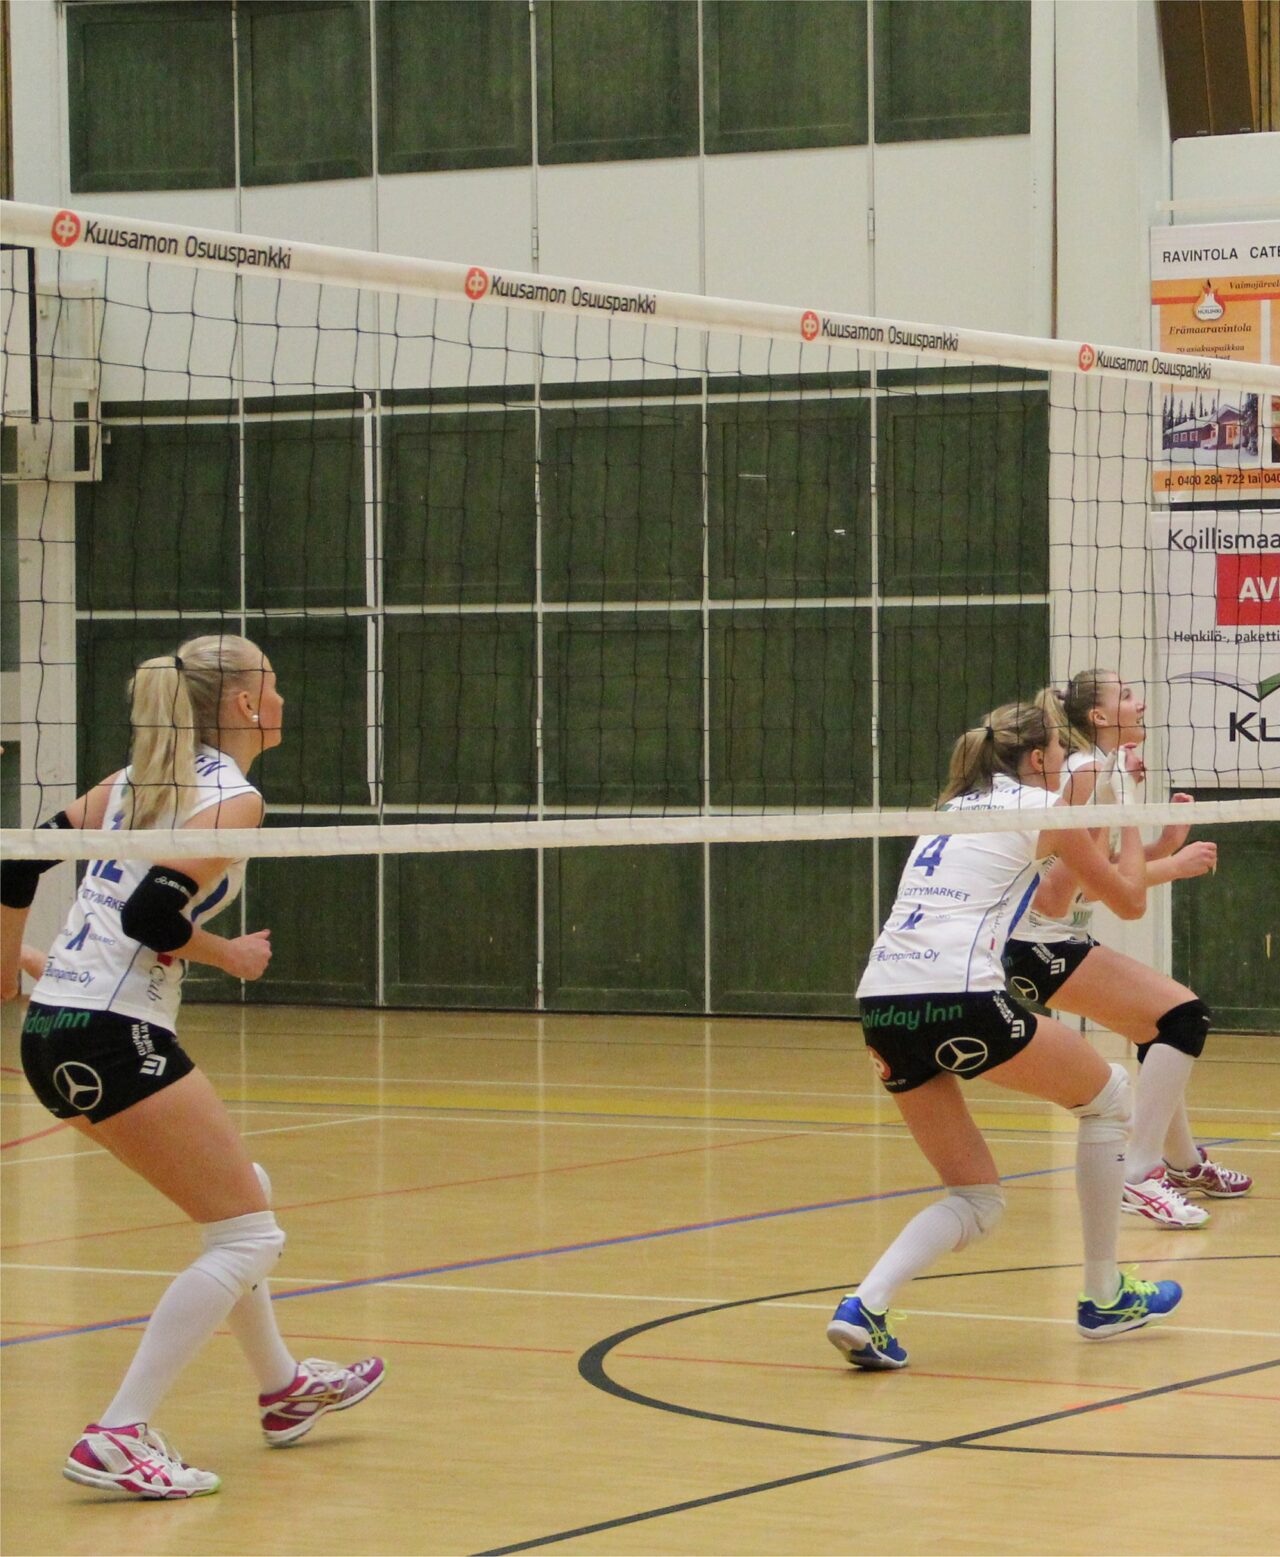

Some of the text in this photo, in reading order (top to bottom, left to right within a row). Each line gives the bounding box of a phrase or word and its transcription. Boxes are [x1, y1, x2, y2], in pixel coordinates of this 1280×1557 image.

[84, 220, 292, 270] Kuusamon Osuuspankki
[1163, 248, 1238, 263] RAVINTOLA
[490, 274, 656, 315] Kuusamon Osuuspankki
[821, 318, 958, 353] Kuusamon Osuuspankki
[1096, 350, 1212, 381] Kuusamon Osuuspankki
[913, 835, 952, 876] 4
[924, 949, 940, 961] Oy
[54, 1008, 90, 1029] Inn
[862, 1002, 963, 1031] oliday Inn
